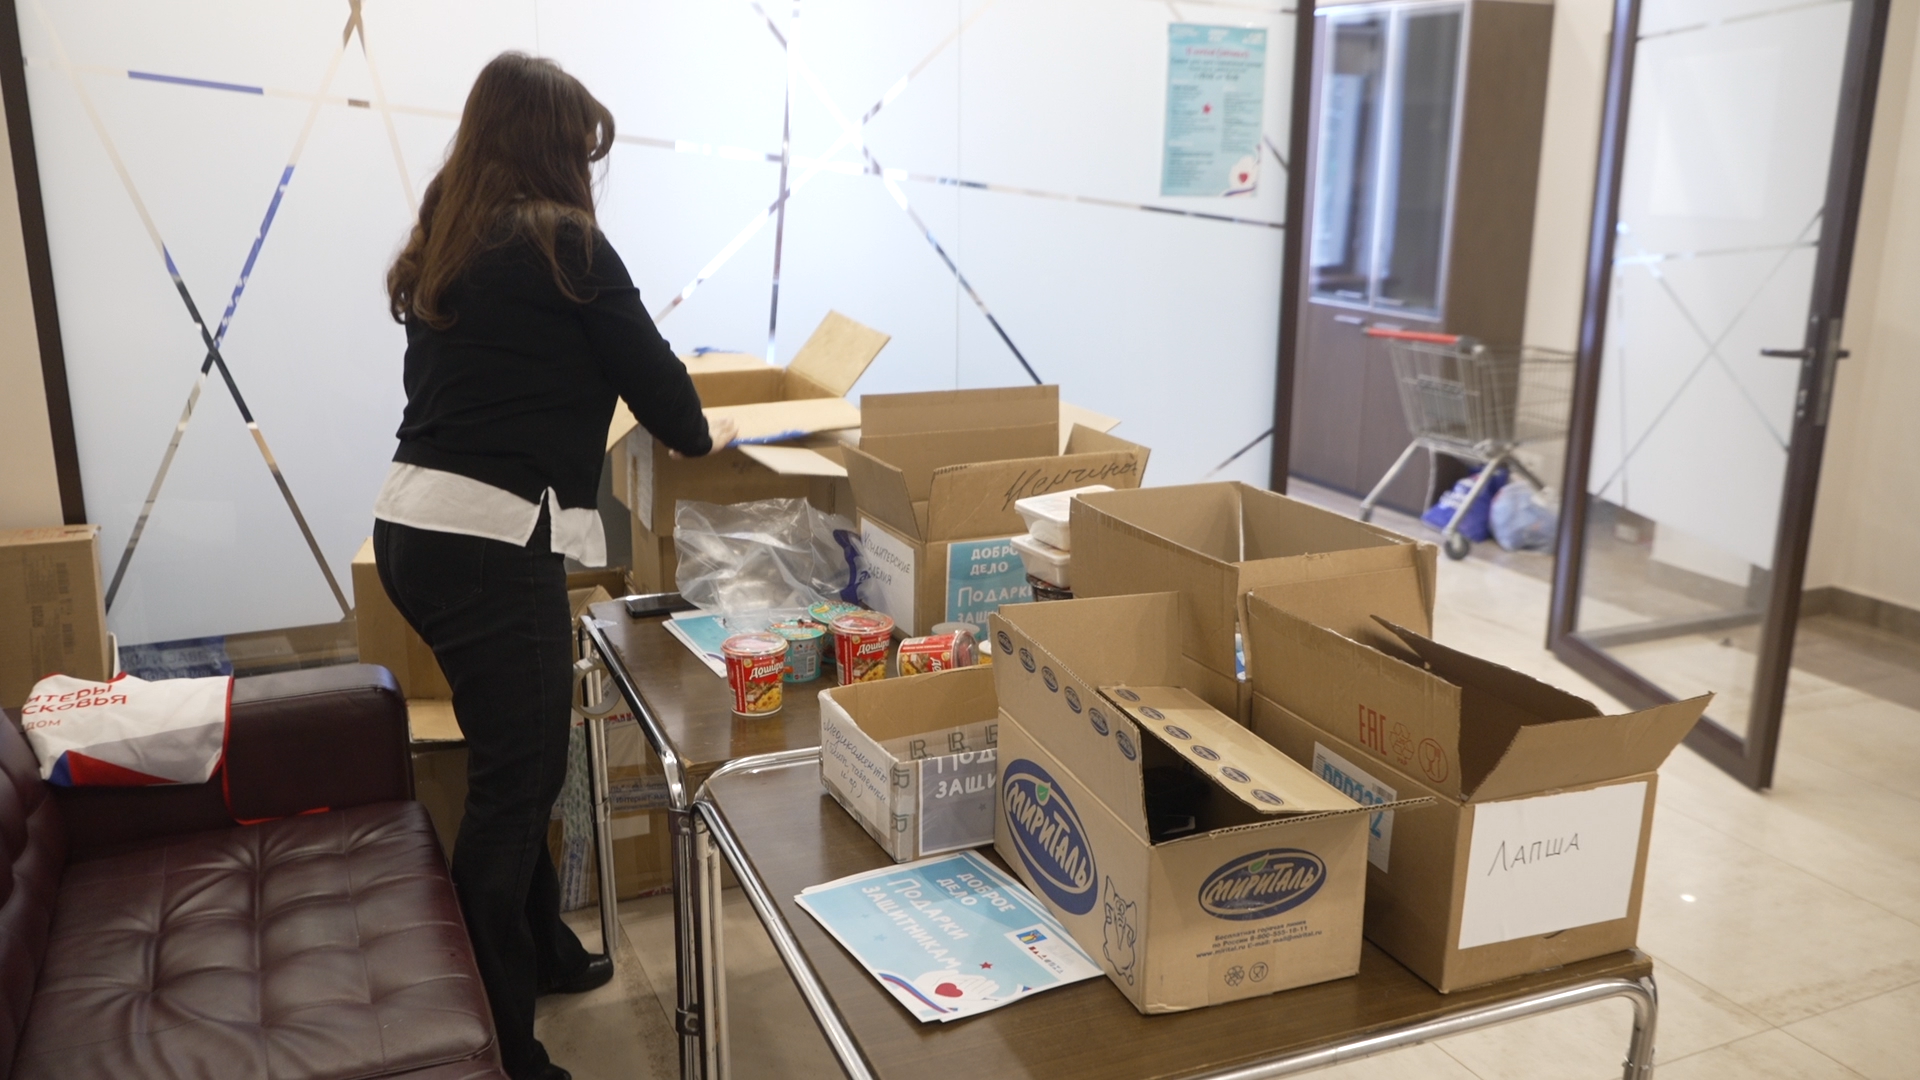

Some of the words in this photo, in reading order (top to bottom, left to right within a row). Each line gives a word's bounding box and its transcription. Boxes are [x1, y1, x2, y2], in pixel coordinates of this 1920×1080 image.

[970, 561, 1008, 576] ДЕЛО
[22, 694, 127, 714] СКОВЬЯ
[936, 878, 977, 906] ДЕЛО
[956, 873, 1016, 912] ДОБРОЕ
[861, 886, 962, 969] ЗАЩИТНИКАМ
[1215, 929, 1256, 941] Бесплатная
[1257, 924, 1285, 935] горячая
[1286, 920, 1307, 929] линия
[1196, 944, 1246, 958] www.mirital.ru
[1223, 936, 1248, 947] России
